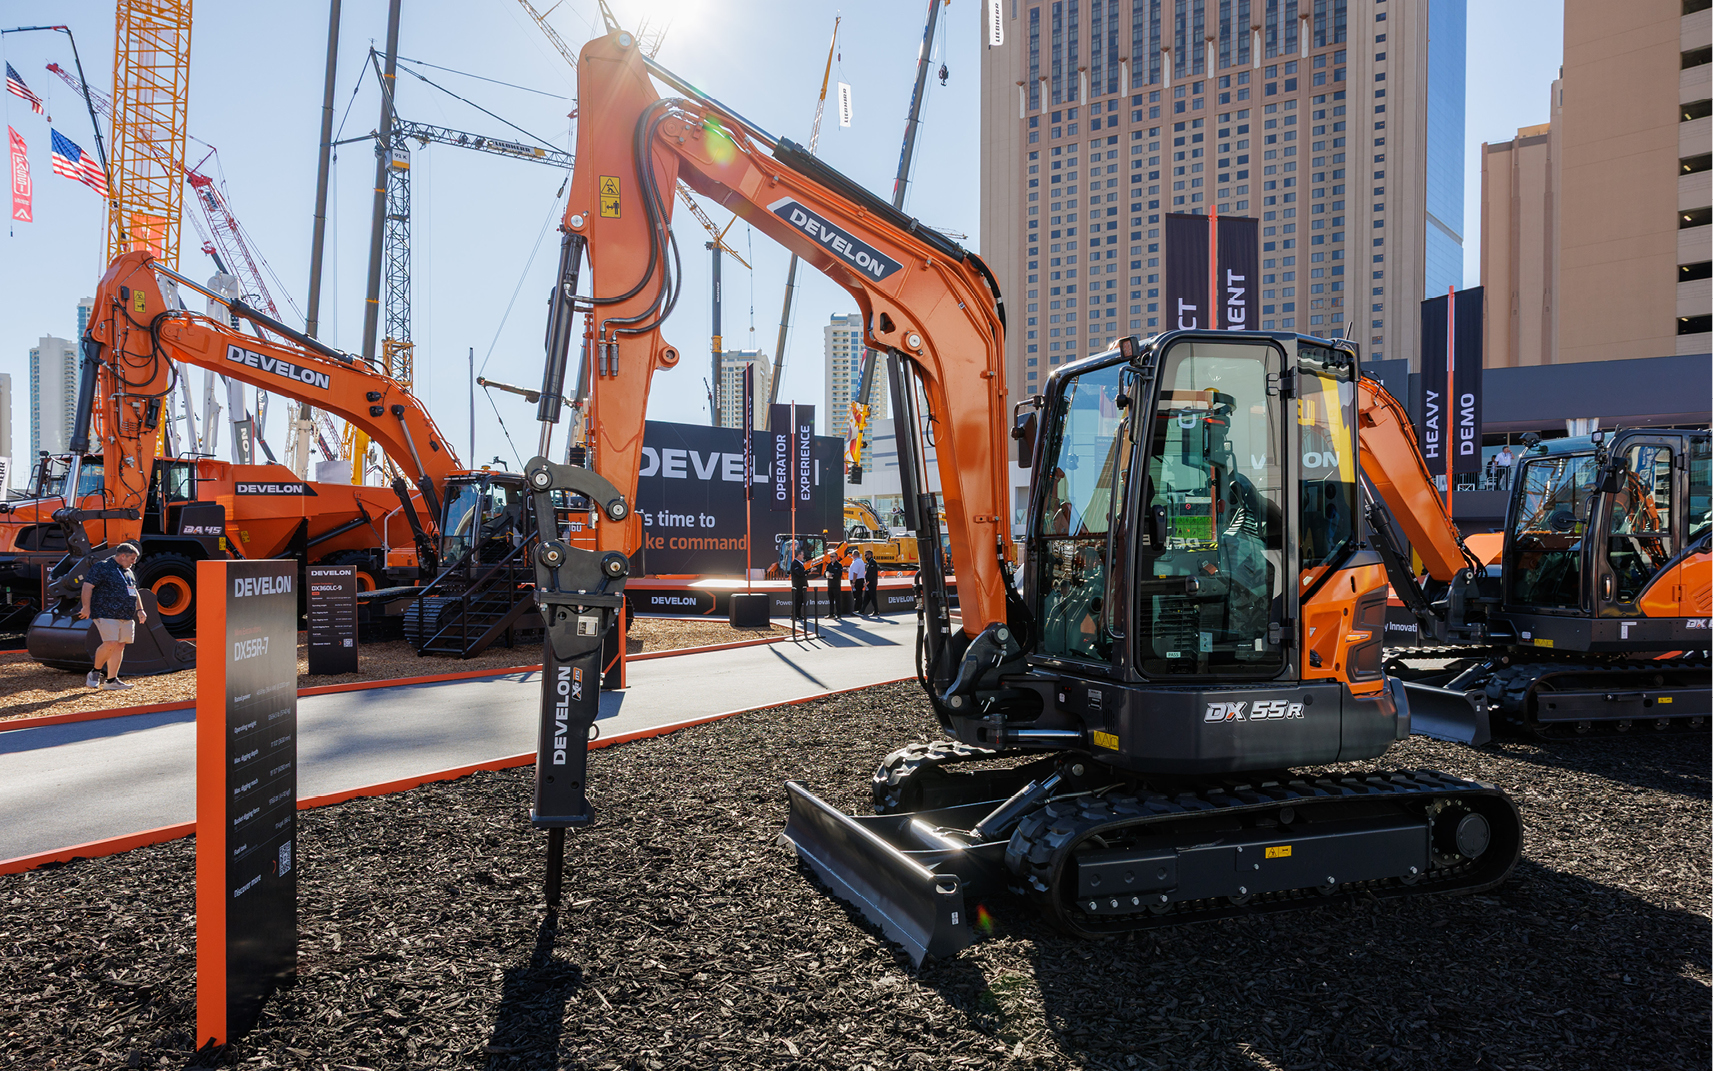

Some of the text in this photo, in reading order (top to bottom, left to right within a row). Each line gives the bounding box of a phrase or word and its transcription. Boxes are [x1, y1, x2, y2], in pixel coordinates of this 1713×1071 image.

[494, 141, 531, 153] LIEBHERR
[789, 208, 885, 277] DEVELON
[227, 344, 330, 389] DEVELON
[1426, 390, 1439, 459] HEAVY
[1460, 393, 1475, 456] DEMO
[776, 434, 786, 500] OPERATOR
[800, 425, 811, 500] EXPERIENCE
[237, 484, 303, 494] DEVELON
[657, 510, 695, 528] time
[698, 512, 716, 528] to
[669, 534, 747, 551] command
[234, 575, 292, 598] DEVELON
[887, 595, 915, 604] DEVELON
[651, 596, 697, 606] DEVELON
[234, 636, 269, 662] DX55R-7
[553, 666, 571, 765] DEVELON
